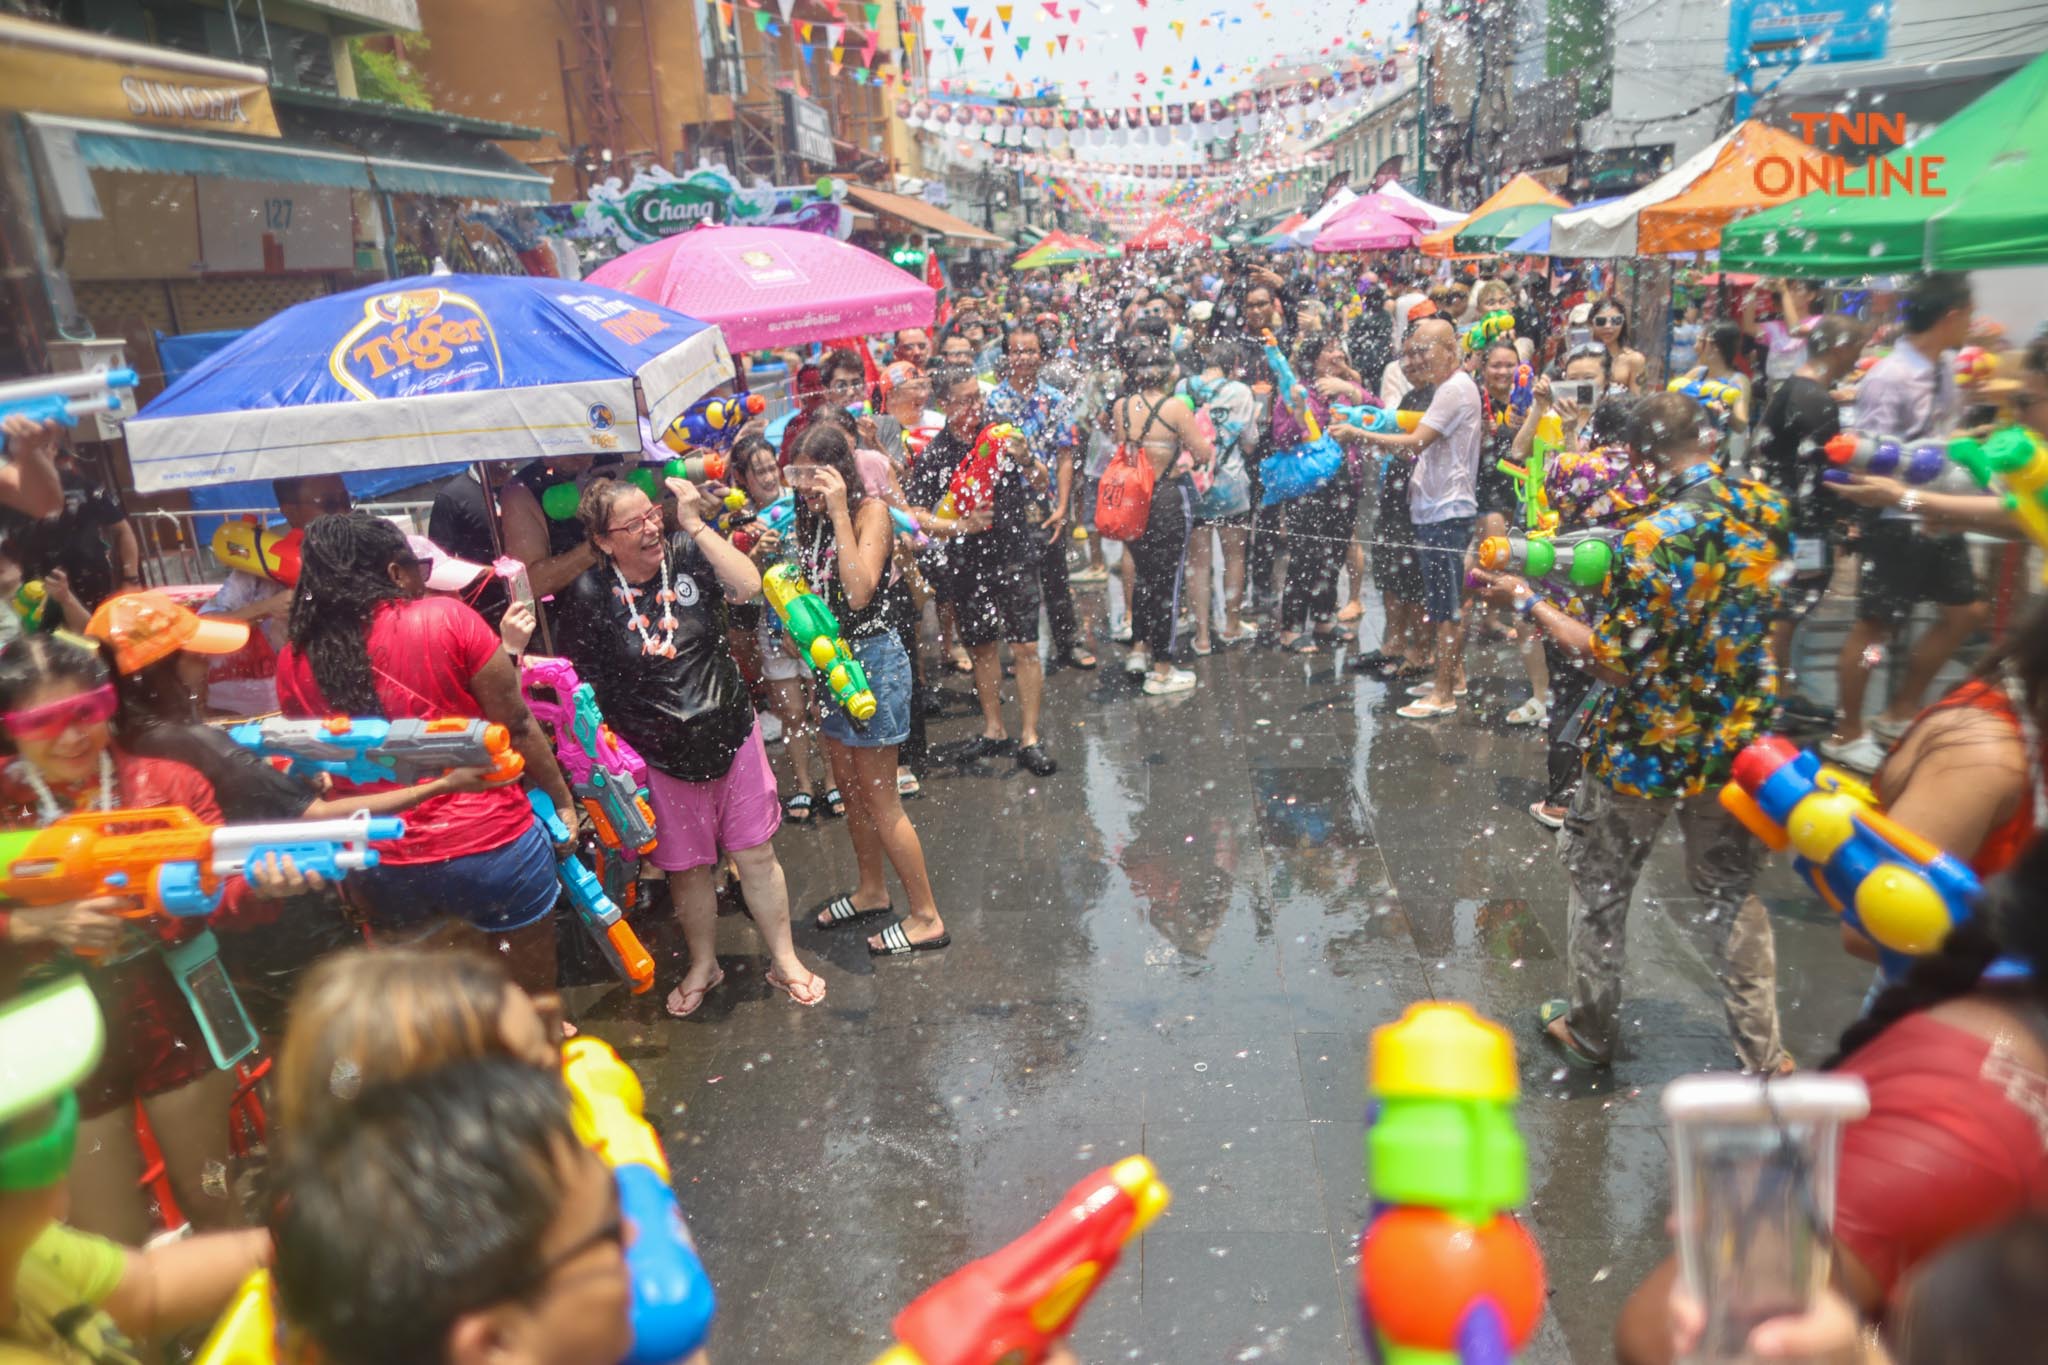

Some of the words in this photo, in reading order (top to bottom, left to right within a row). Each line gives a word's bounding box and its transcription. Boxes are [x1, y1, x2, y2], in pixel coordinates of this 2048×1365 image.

[121, 75, 249, 123] SINGHA
[264, 198, 292, 229] 127
[643, 198, 715, 223] Chang
[353, 314, 484, 378] Tiger
